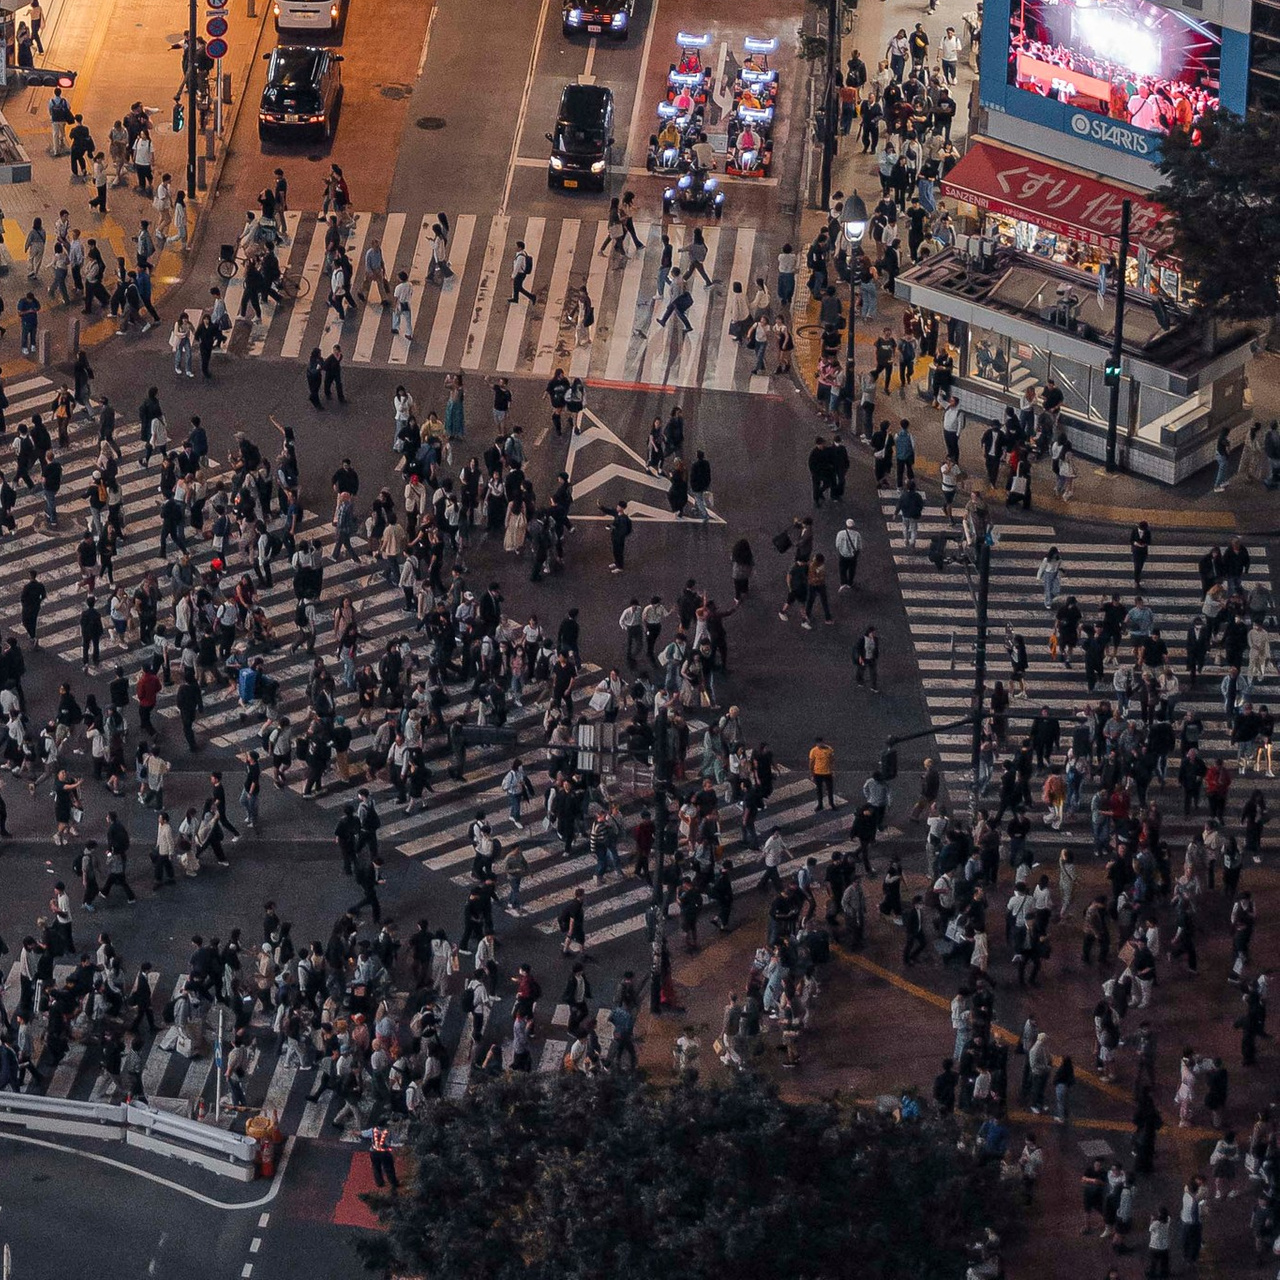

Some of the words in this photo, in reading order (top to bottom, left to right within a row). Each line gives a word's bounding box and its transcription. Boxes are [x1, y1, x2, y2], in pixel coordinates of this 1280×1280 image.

[1052, 78, 1076, 95] SZA
[945, 186, 989, 209] SANZENRI
[996, 166, 1081, 209] くすり
